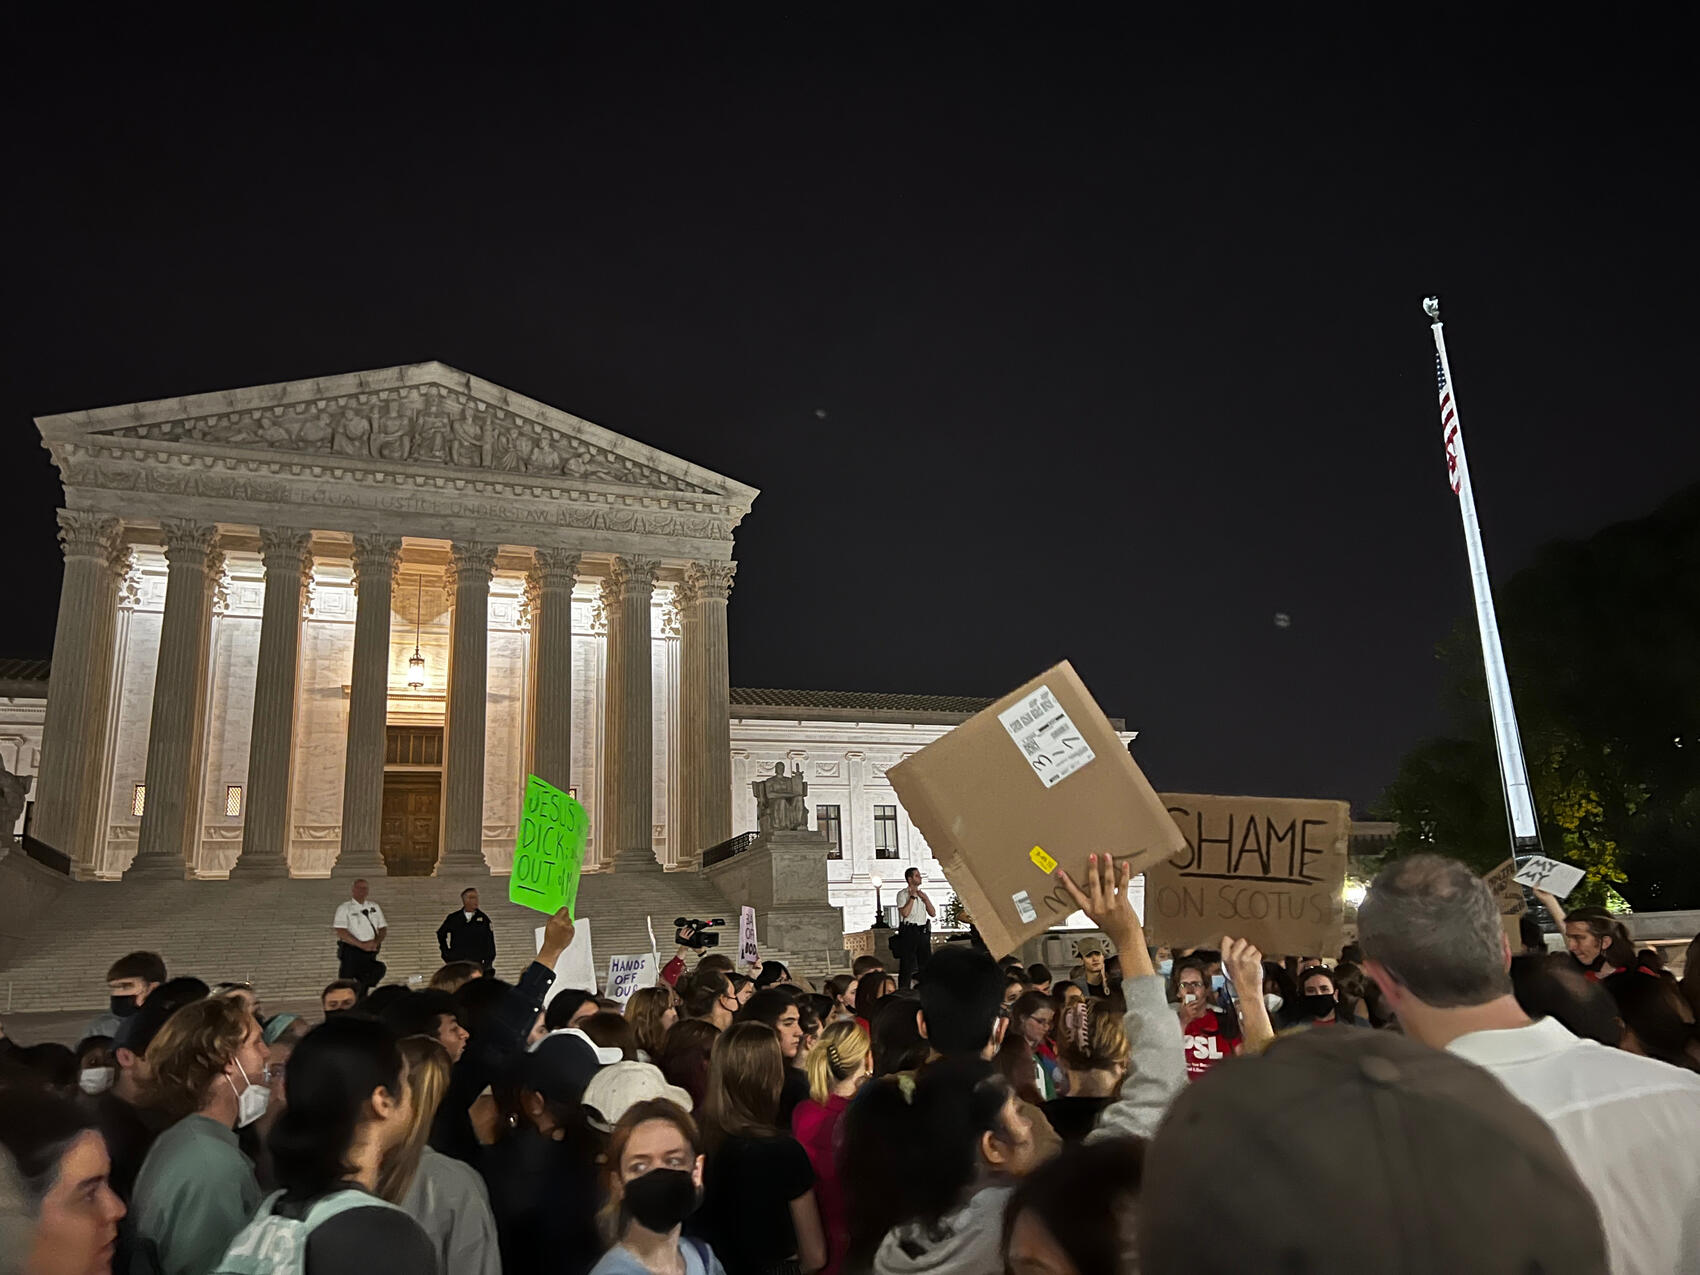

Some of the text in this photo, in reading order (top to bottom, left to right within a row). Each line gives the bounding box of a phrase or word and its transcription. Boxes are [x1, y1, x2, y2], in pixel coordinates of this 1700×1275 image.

[302, 488, 364, 506] EQUAL
[450, 502, 508, 518] UNDER
[514, 508, 549, 521] LAW
[1167, 806, 1329, 882] SHAME
[517, 854, 556, 887] OUT
[1517, 871, 1550, 886] MY
[1529, 860, 1560, 873] MY
[1157, 884, 1323, 923] ON SCOTUS
[611, 959, 645, 972] HANDS
[614, 972, 637, 985] OFF
[1183, 1034, 1224, 1060] PSL
